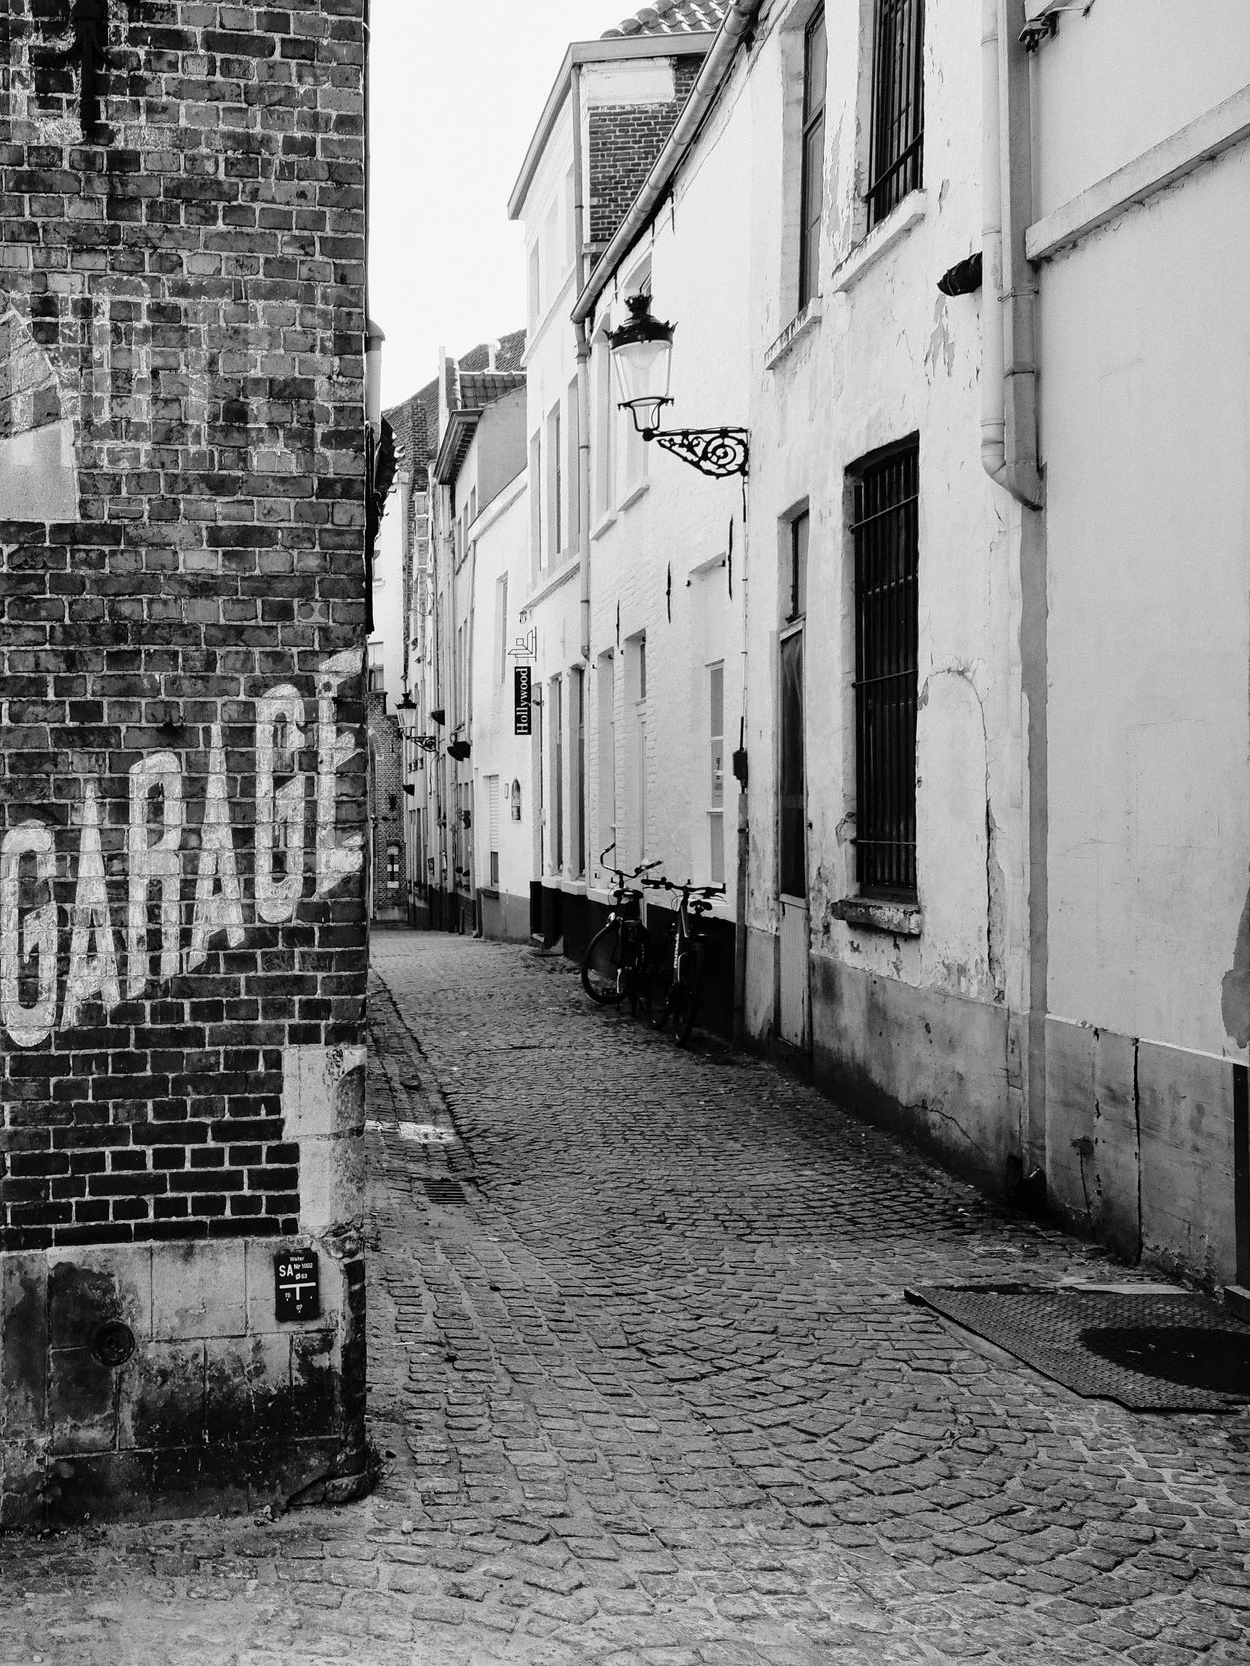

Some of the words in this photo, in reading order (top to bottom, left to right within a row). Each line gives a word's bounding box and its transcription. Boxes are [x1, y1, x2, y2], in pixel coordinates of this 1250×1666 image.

[515, 667, 531, 734] Hollywood
[0, 647, 364, 1047] GARAGE
[278, 1264, 294, 1277] SA
